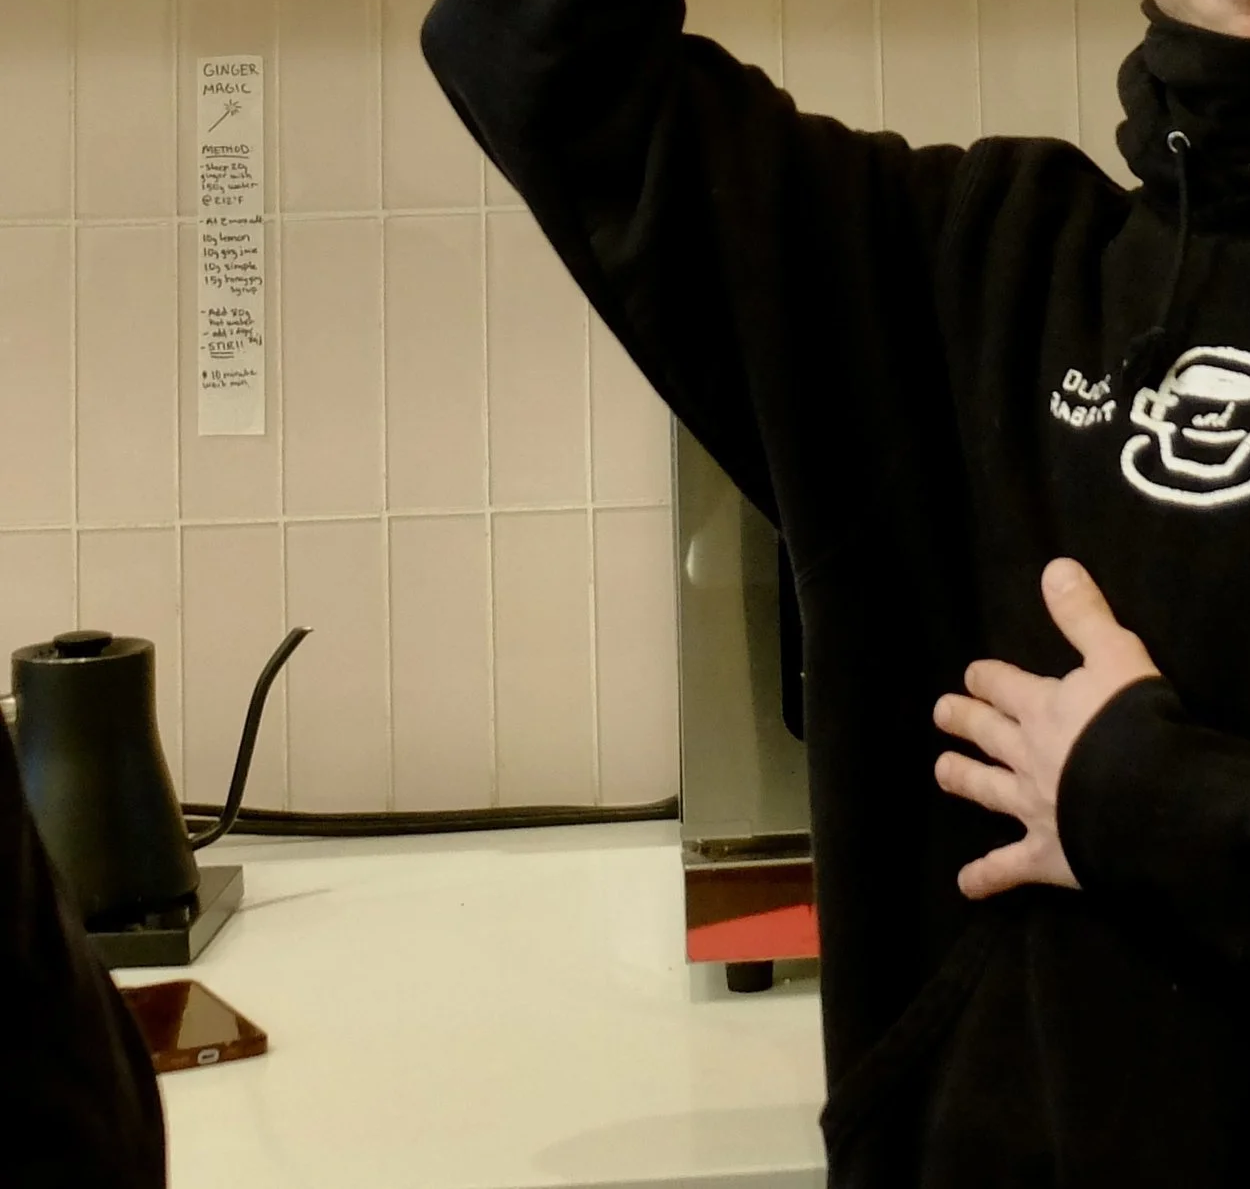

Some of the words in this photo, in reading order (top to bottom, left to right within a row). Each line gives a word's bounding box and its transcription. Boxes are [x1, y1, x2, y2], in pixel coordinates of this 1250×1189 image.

[203, 62, 260, 78] GINGER
[203, 82, 252, 96] MAGIC
[201, 144, 250, 155] METHOD
[219, 231, 250, 242] lemon
[203, 247, 219, 259] 10g
[204, 262, 221, 274] 10g
[205, 275, 222, 289] 15g
[230, 285, 258, 297] syrup
